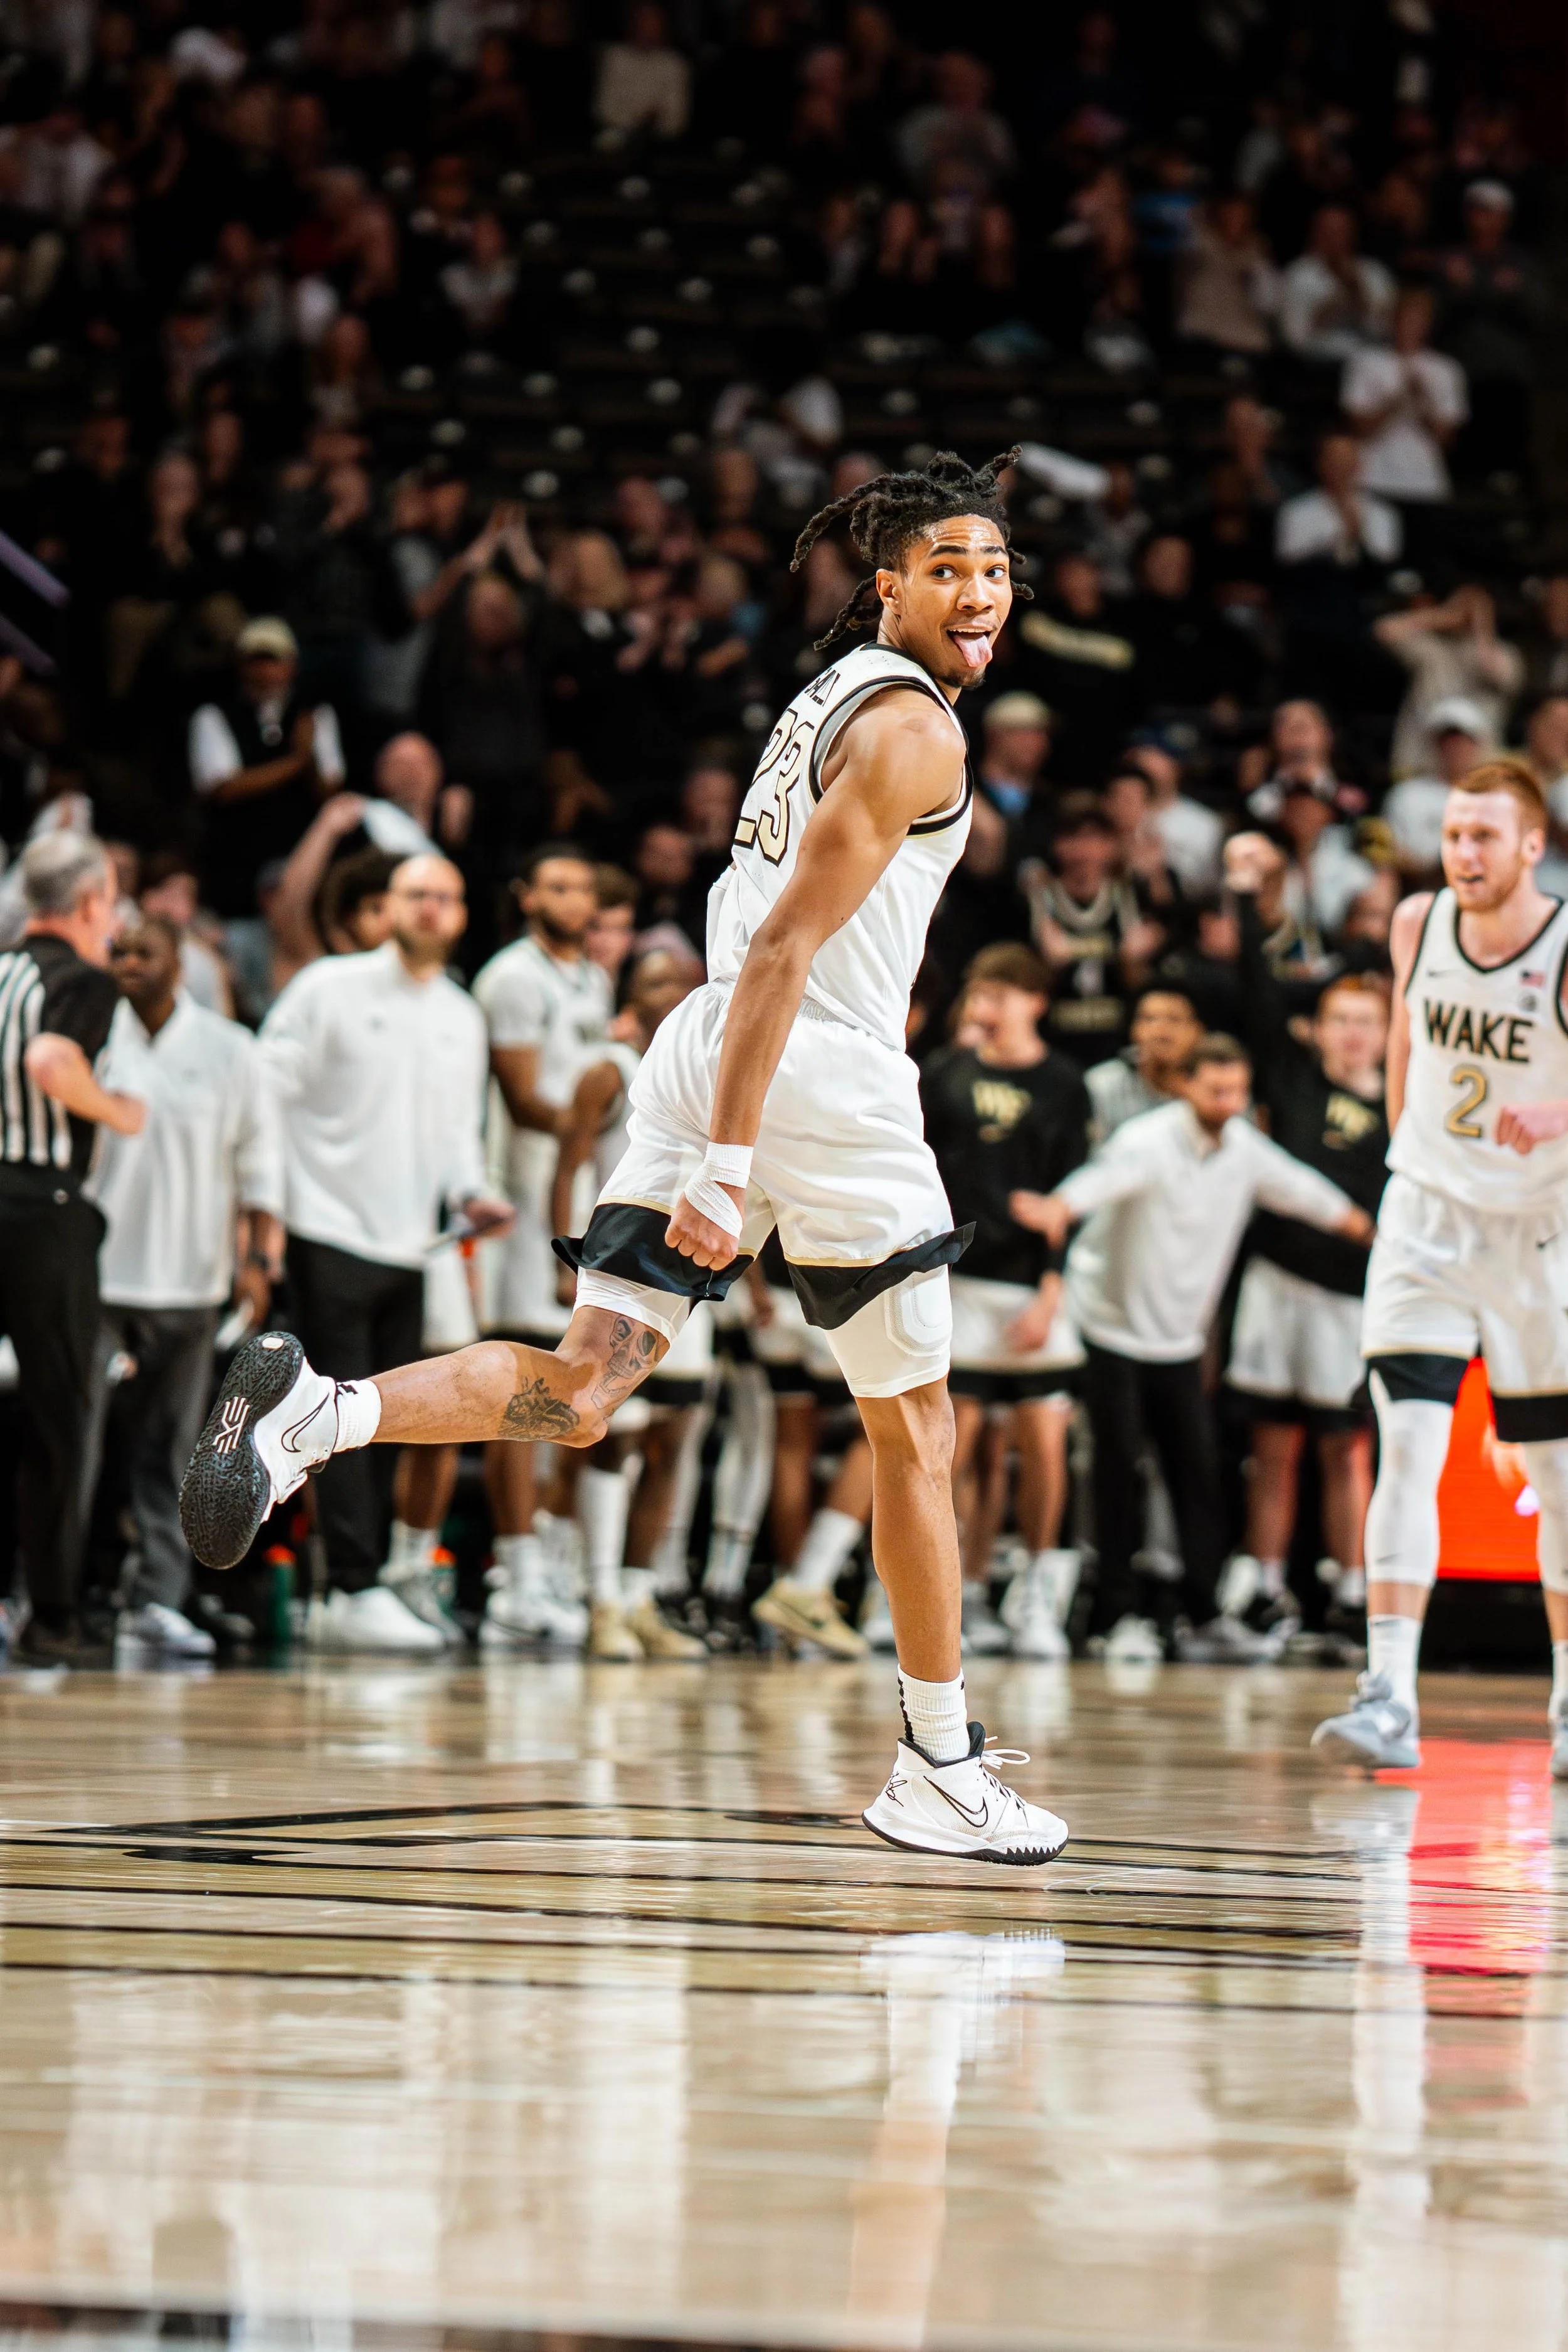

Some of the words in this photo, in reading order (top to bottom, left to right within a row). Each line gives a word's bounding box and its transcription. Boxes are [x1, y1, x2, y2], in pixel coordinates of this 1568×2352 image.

[733, 708, 815, 868] 23
[1424, 999, 1534, 1063] WAKE
[1446, 1064, 1488, 1139] 2
